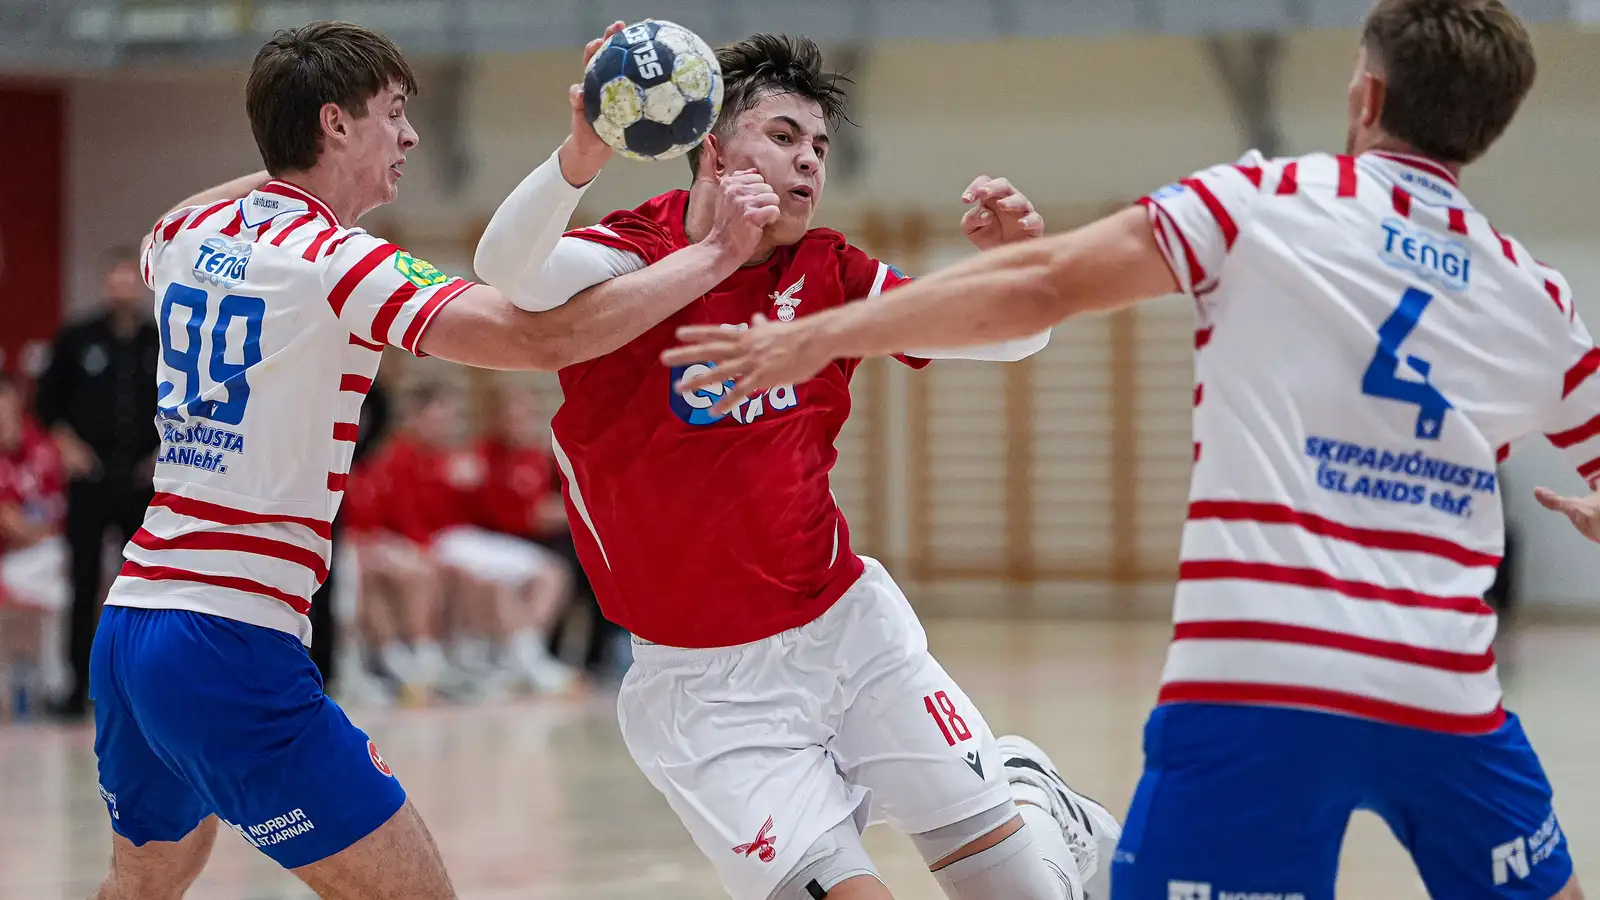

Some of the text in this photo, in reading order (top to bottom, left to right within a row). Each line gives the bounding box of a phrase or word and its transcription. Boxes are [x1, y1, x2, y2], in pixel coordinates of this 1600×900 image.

[622, 22, 663, 80] SELEC
[196, 245, 250, 281] TENGI
[1381, 222, 1471, 285] TENGI
[157, 282, 266, 426] 99
[1361, 286, 1454, 441] 4
[1303, 435, 1496, 495] SKIPAÞJÓNUSTA
[1315, 464, 1474, 518] ÍSLANDS ehf.
[923, 690, 972, 747] 18
[248, 807, 307, 837] NORÐUR
[258, 818, 315, 847] STJARNAN
